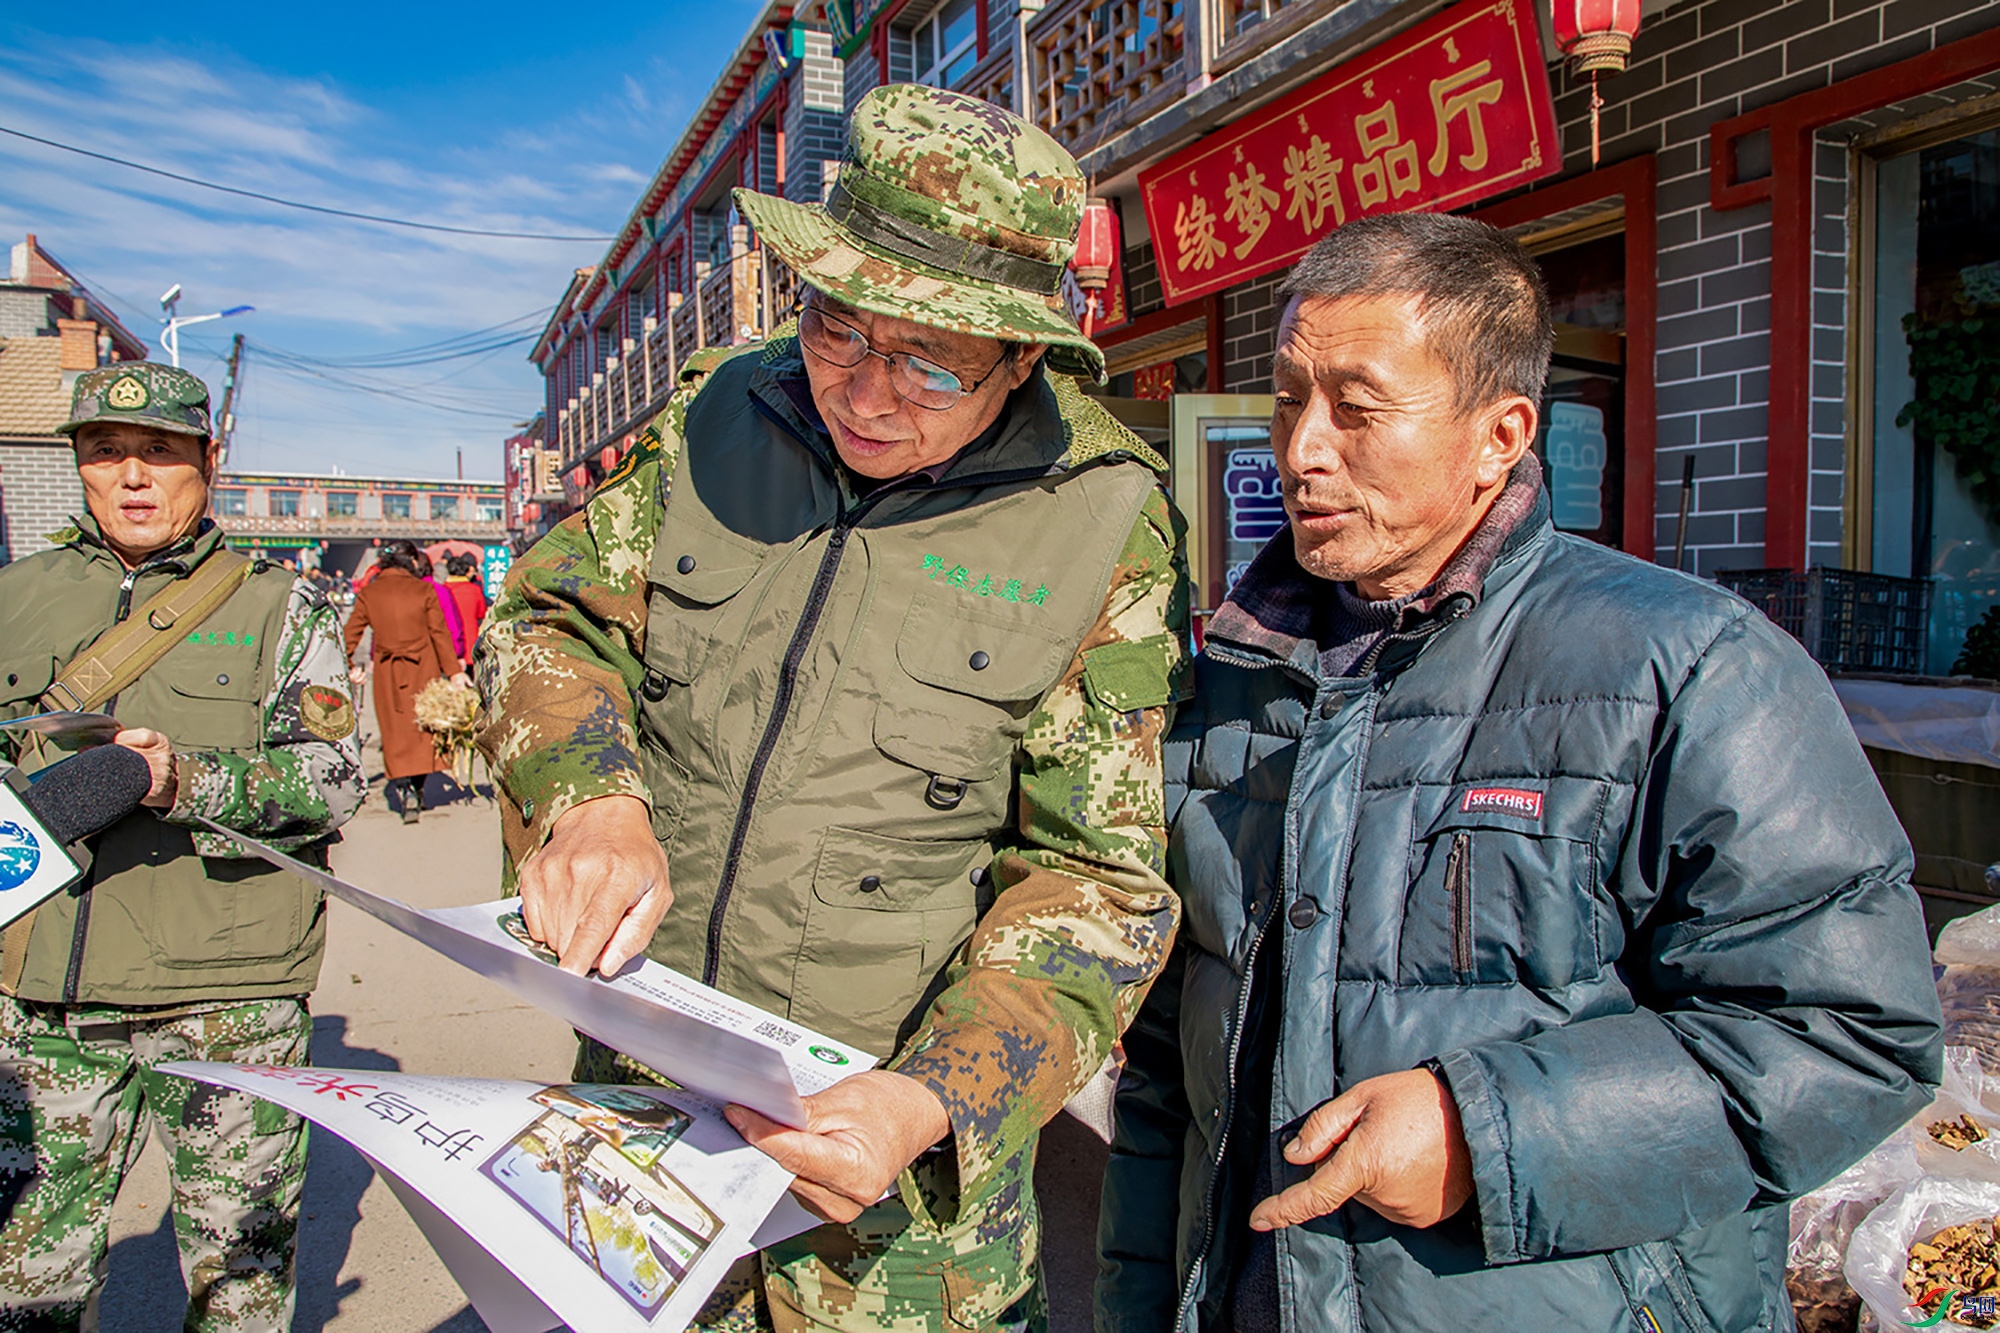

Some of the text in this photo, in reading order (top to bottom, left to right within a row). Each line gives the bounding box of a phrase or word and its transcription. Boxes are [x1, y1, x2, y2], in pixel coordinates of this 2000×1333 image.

[1174, 59, 1504, 272] 缘梦精品厅
[920, 553, 1052, 607] 野保志愿者
[1471, 793, 1535, 812] SKECHRS
